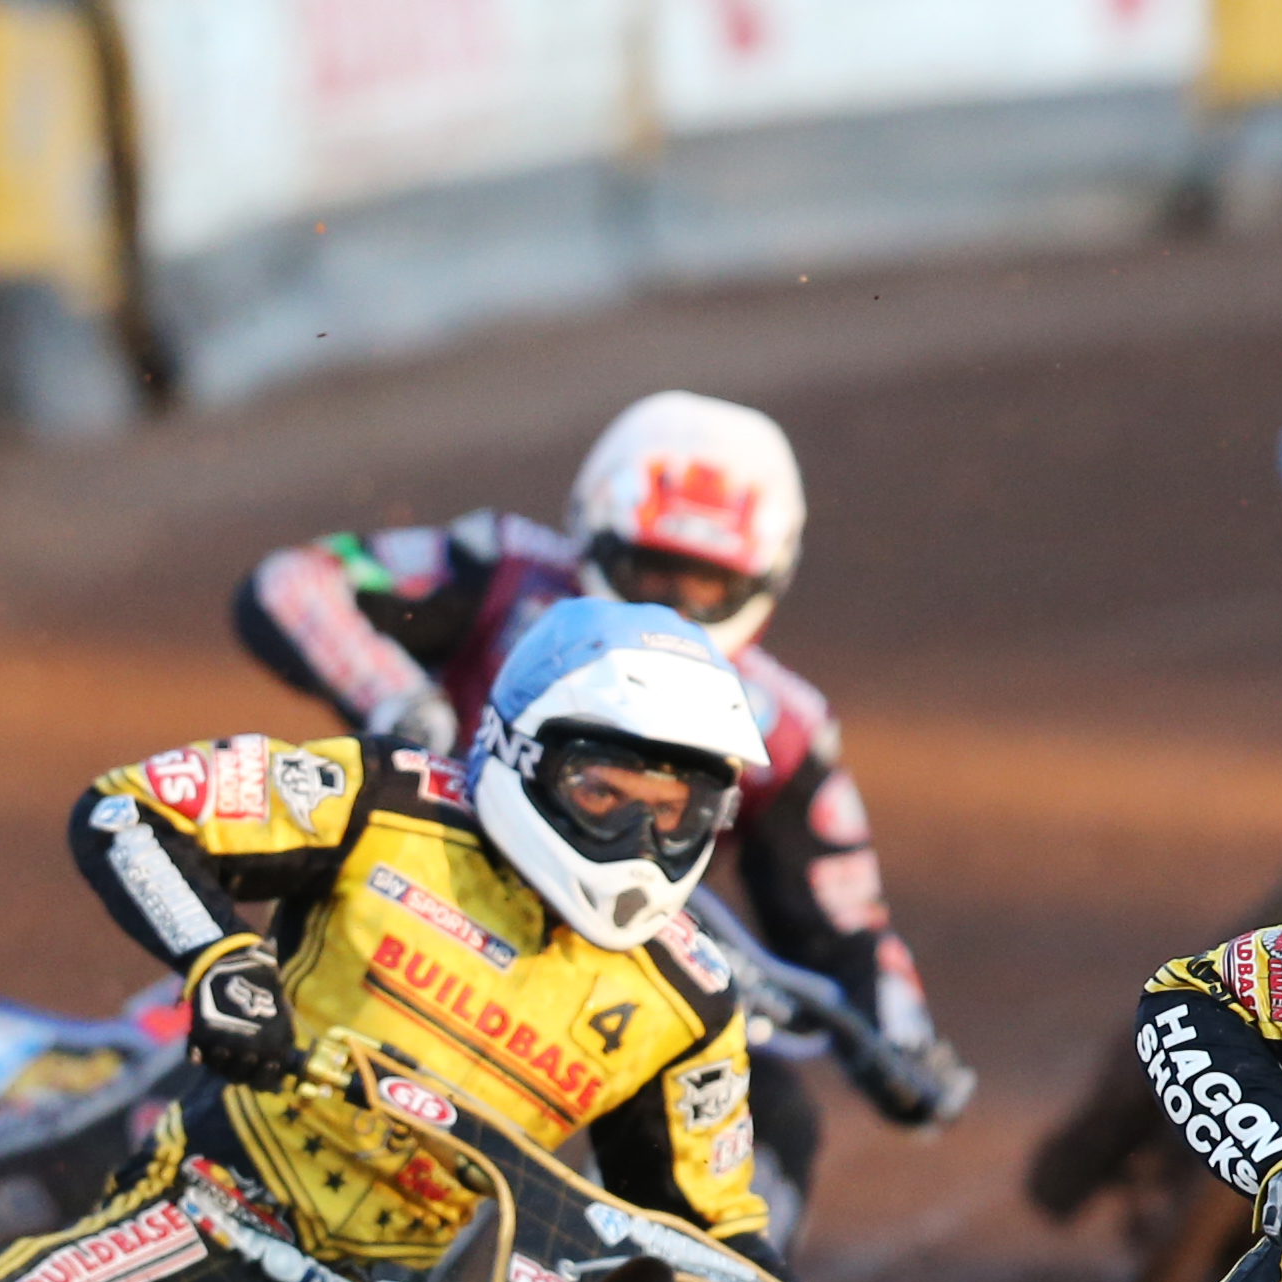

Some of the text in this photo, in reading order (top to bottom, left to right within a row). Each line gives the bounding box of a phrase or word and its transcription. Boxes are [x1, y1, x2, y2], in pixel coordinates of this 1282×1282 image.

[406, 890, 487, 950] SPORTS
[372, 933, 605, 1110] BUILDBASE
[588, 1002, 639, 1054] 4
[1136, 1023, 1259, 1195] SHOCKS
